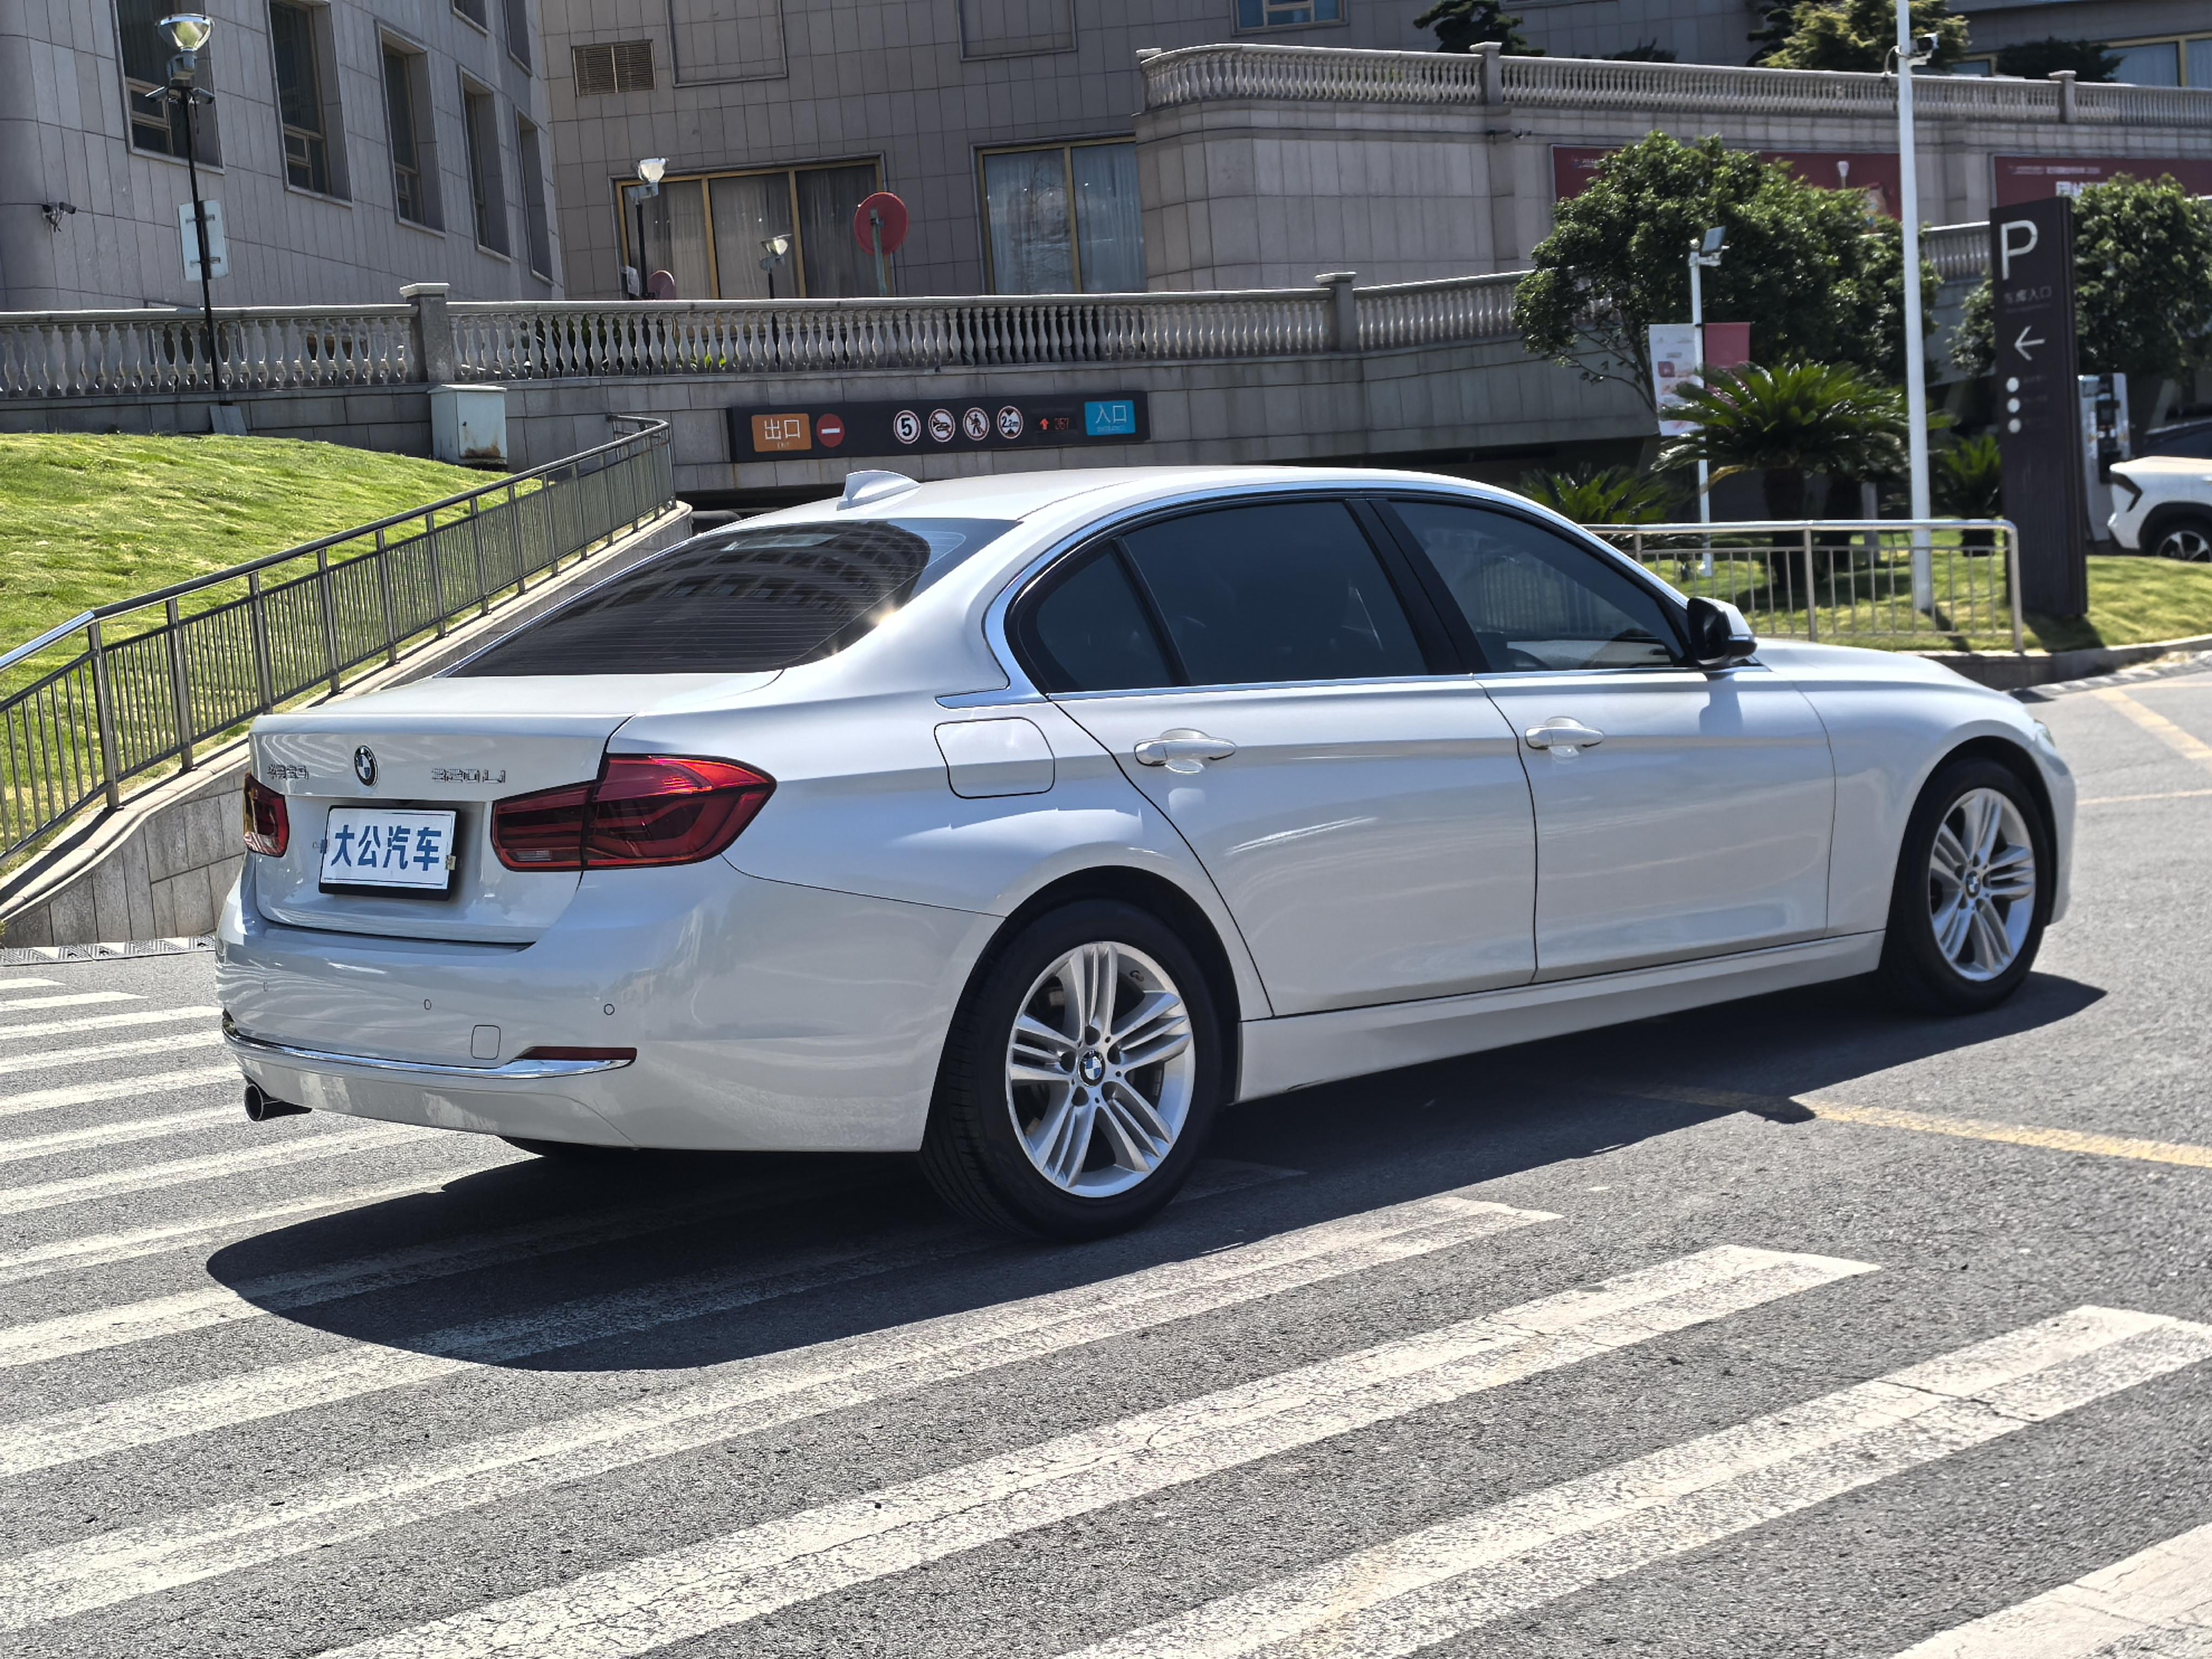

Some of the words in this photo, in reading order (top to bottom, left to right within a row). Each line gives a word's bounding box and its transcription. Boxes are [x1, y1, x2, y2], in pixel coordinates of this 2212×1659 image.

[2000, 219, 2038, 281] P
[1095, 404, 1127, 424] 入口
[765, 418, 800, 440] 出口
[901, 417, 912, 436] 5
[331, 824, 442, 872] 大公汽车
